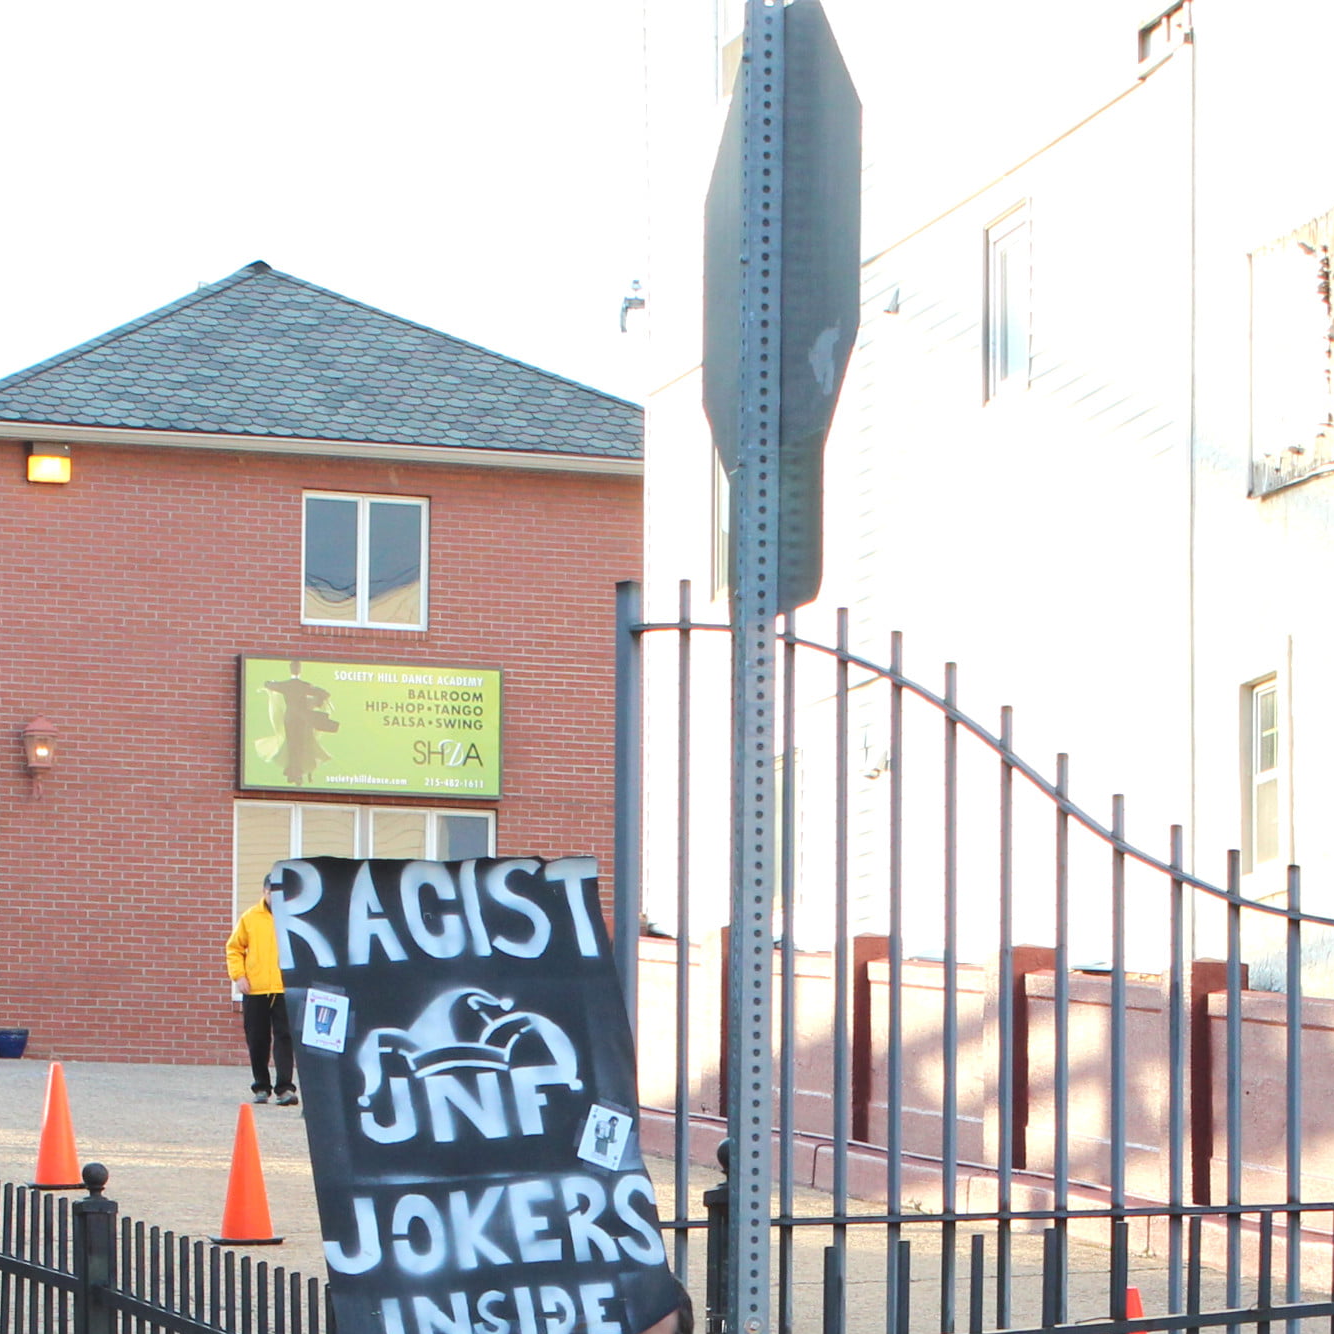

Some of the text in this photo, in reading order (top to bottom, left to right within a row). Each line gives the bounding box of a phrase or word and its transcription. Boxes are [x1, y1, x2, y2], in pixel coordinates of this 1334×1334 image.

[333, 670, 483, 687] SOCIETY HILL DANCE ACADEMY
[408, 689, 483, 703] BALLROOM
[365, 701, 483, 716] HIP-HOP TANGO
[383, 715, 483, 730] SALSA SWING
[326, 775, 484, 789] societyhilldance.com 215-482-1611
[270, 857, 598, 969] RACIST
[359, 1064, 551, 1144] JNF
[323, 1175, 666, 1275] JOKERS
